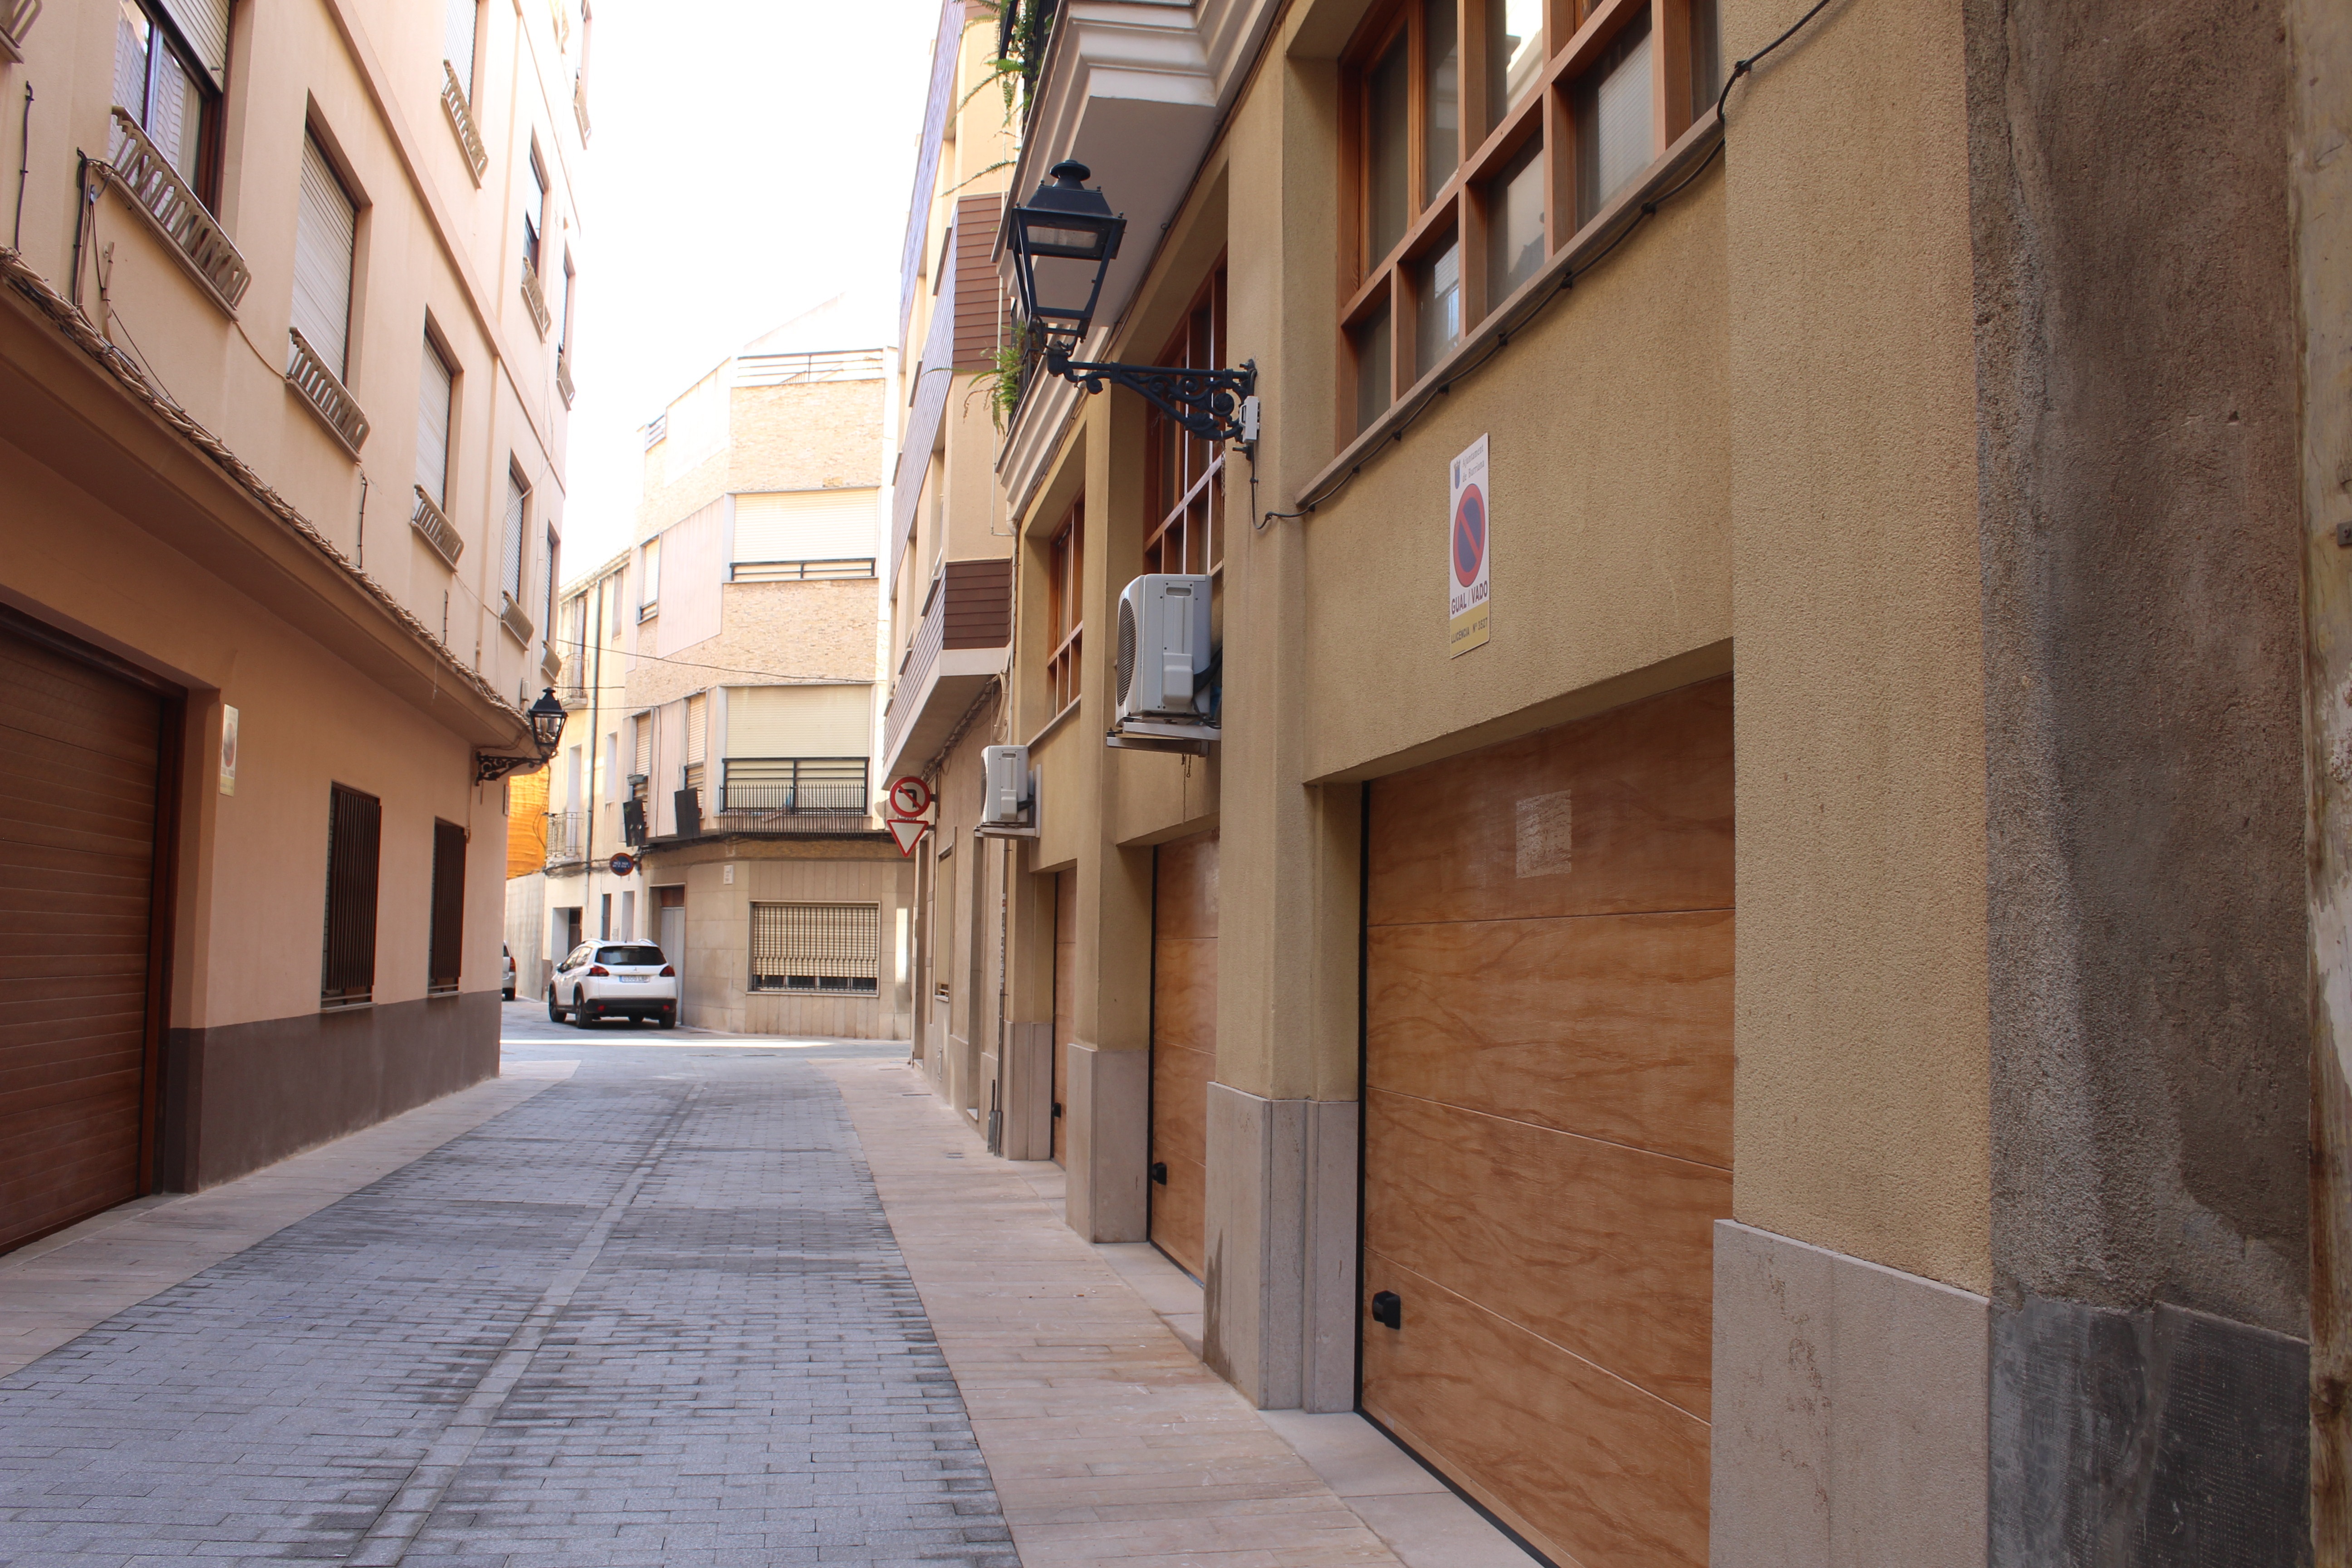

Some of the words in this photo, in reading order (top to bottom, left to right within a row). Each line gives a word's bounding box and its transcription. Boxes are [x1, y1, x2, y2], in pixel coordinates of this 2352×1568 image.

[1462, 444, 1484, 468] Ajuntament
[1462, 473, 1467, 483] de
[1468, 460, 1485, 478] Burriana
[1451, 593, 1467, 615] GUAL
[1471, 580, 1488, 604] VADO
[1478, 617, 1487, 631] 3527
